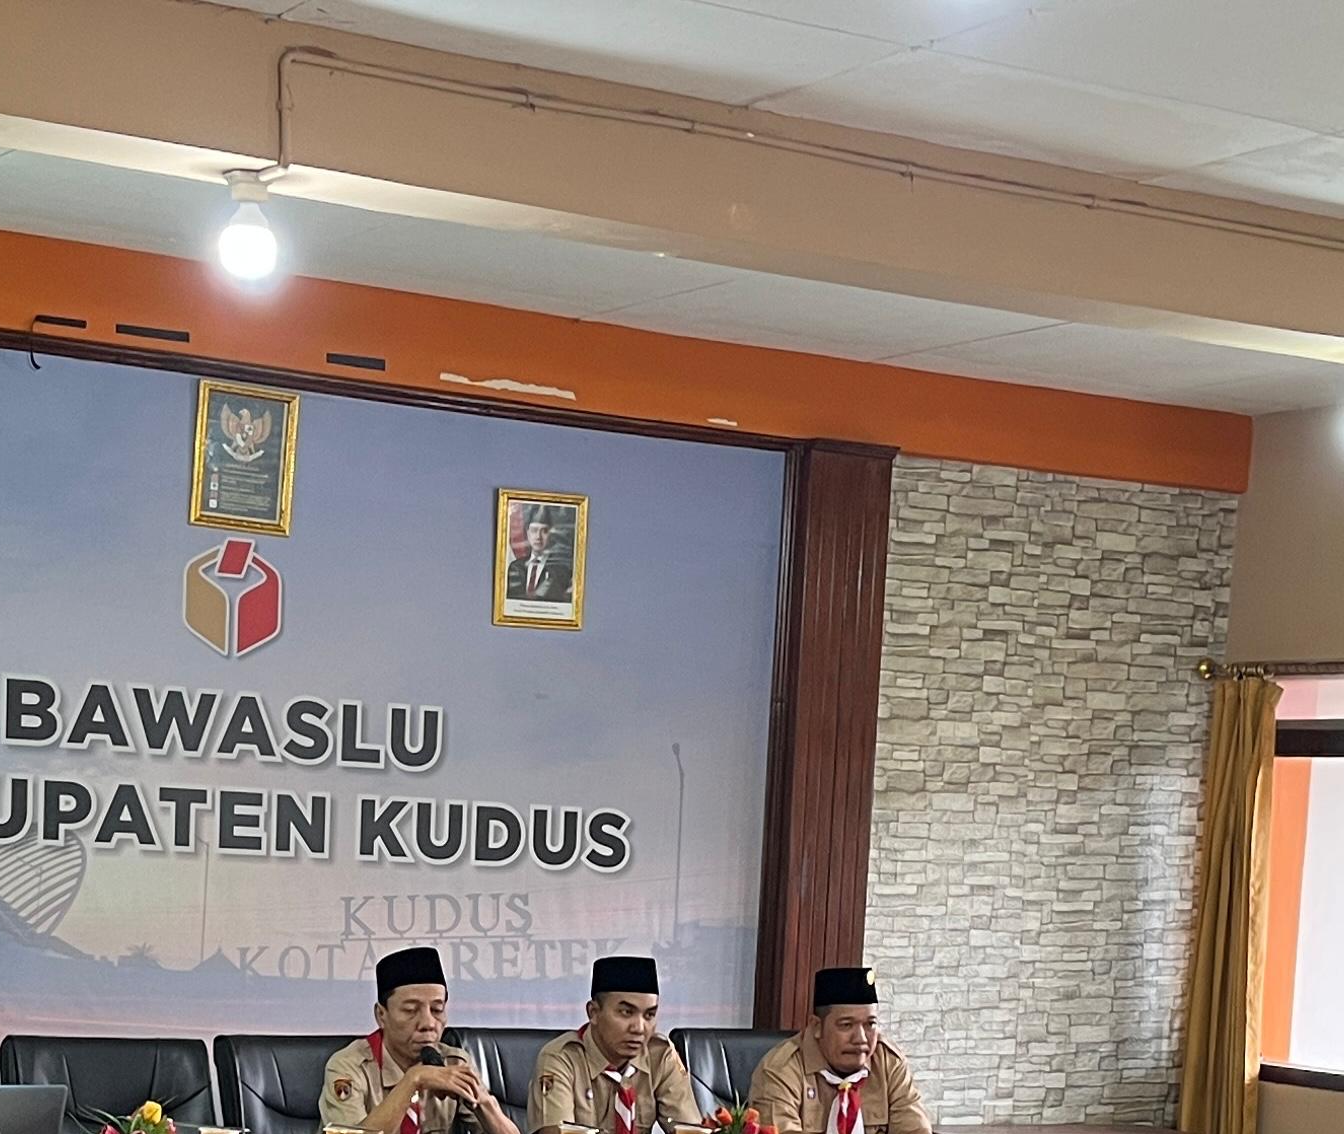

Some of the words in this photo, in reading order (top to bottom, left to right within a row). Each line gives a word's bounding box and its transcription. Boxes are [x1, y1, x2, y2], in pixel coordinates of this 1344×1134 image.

[3, 676, 444, 770] BAWASLU
[358, 798, 630, 871] KUDUS
[340, 892, 533, 937] KUDUS
[236, 941, 377, 981] KOTA
[407, 937, 627, 980] RETE
